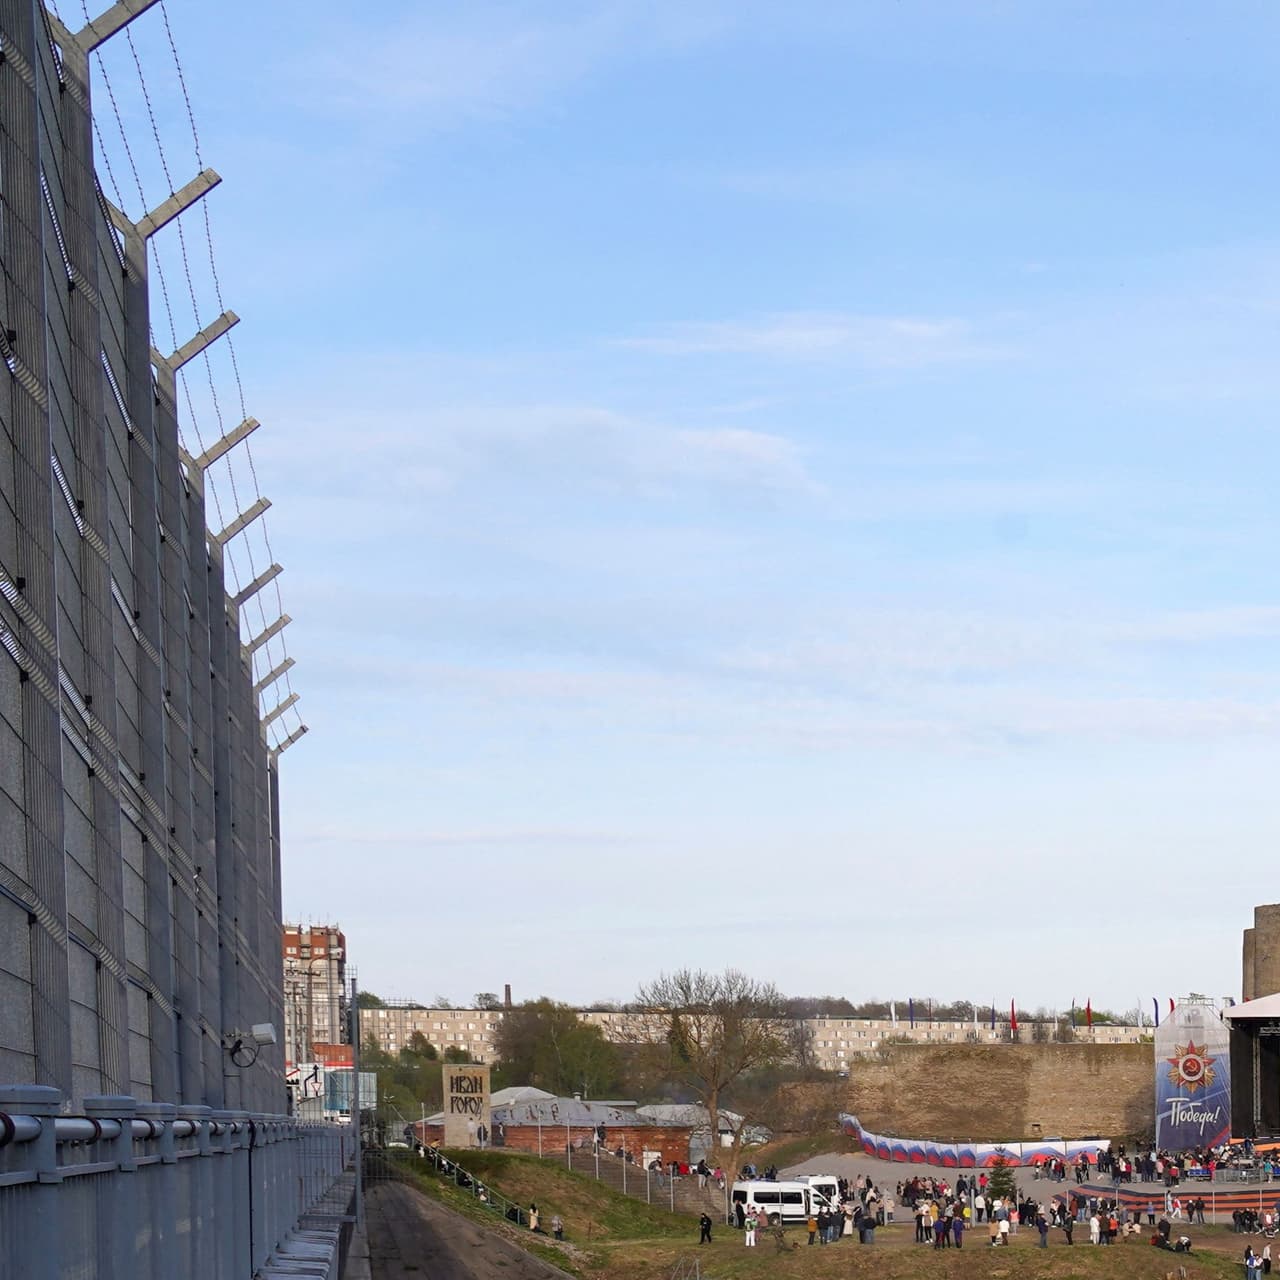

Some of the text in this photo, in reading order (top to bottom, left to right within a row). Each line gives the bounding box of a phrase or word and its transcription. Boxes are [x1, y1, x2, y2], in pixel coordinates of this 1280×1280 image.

[450, 1076, 483, 1093] ИВАН
[450, 1096, 483, 1120] ГОРОД
[1165, 1097, 1221, 1136] Победа!
